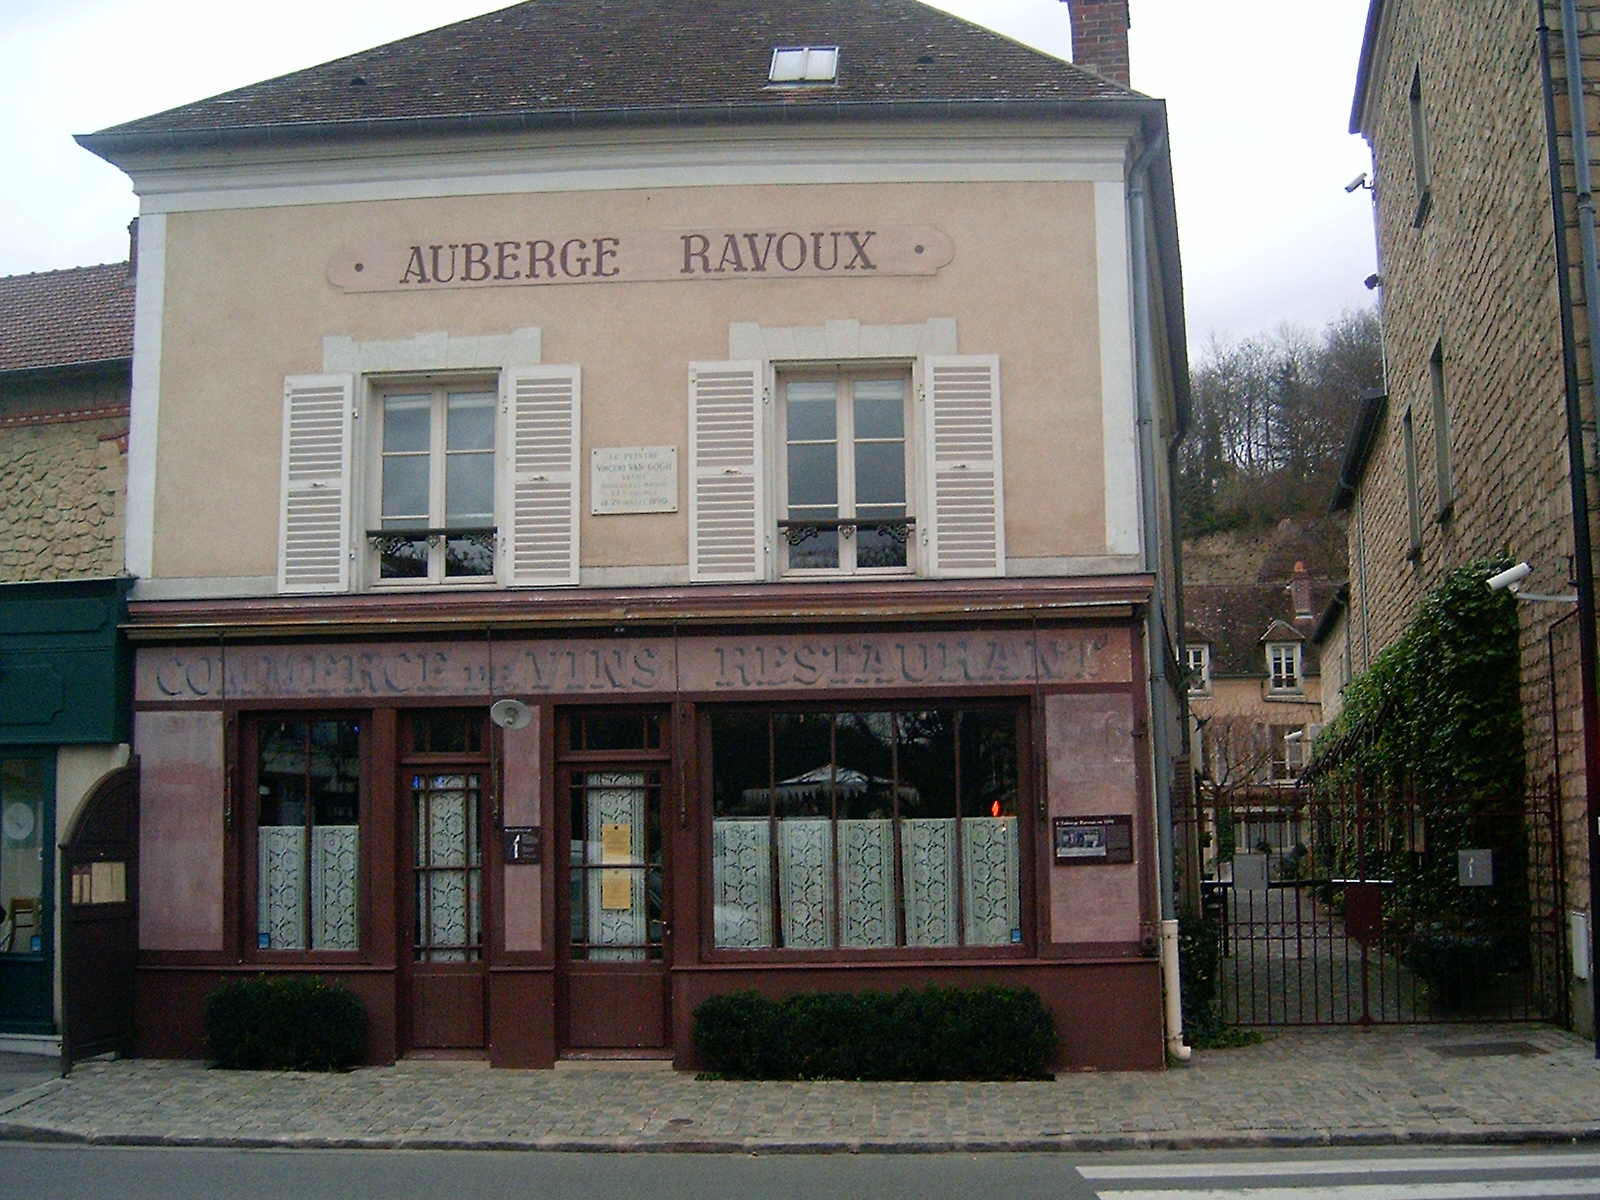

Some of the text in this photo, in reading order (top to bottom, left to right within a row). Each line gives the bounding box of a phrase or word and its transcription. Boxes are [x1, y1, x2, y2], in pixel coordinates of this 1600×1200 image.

[400, 231, 877, 284] AUBERGE RAVOUX
[156, 652, 448, 697] COMMERCE
[525, 647, 660, 692] VINS
[714, 636, 1109, 686] RESTAURANT
